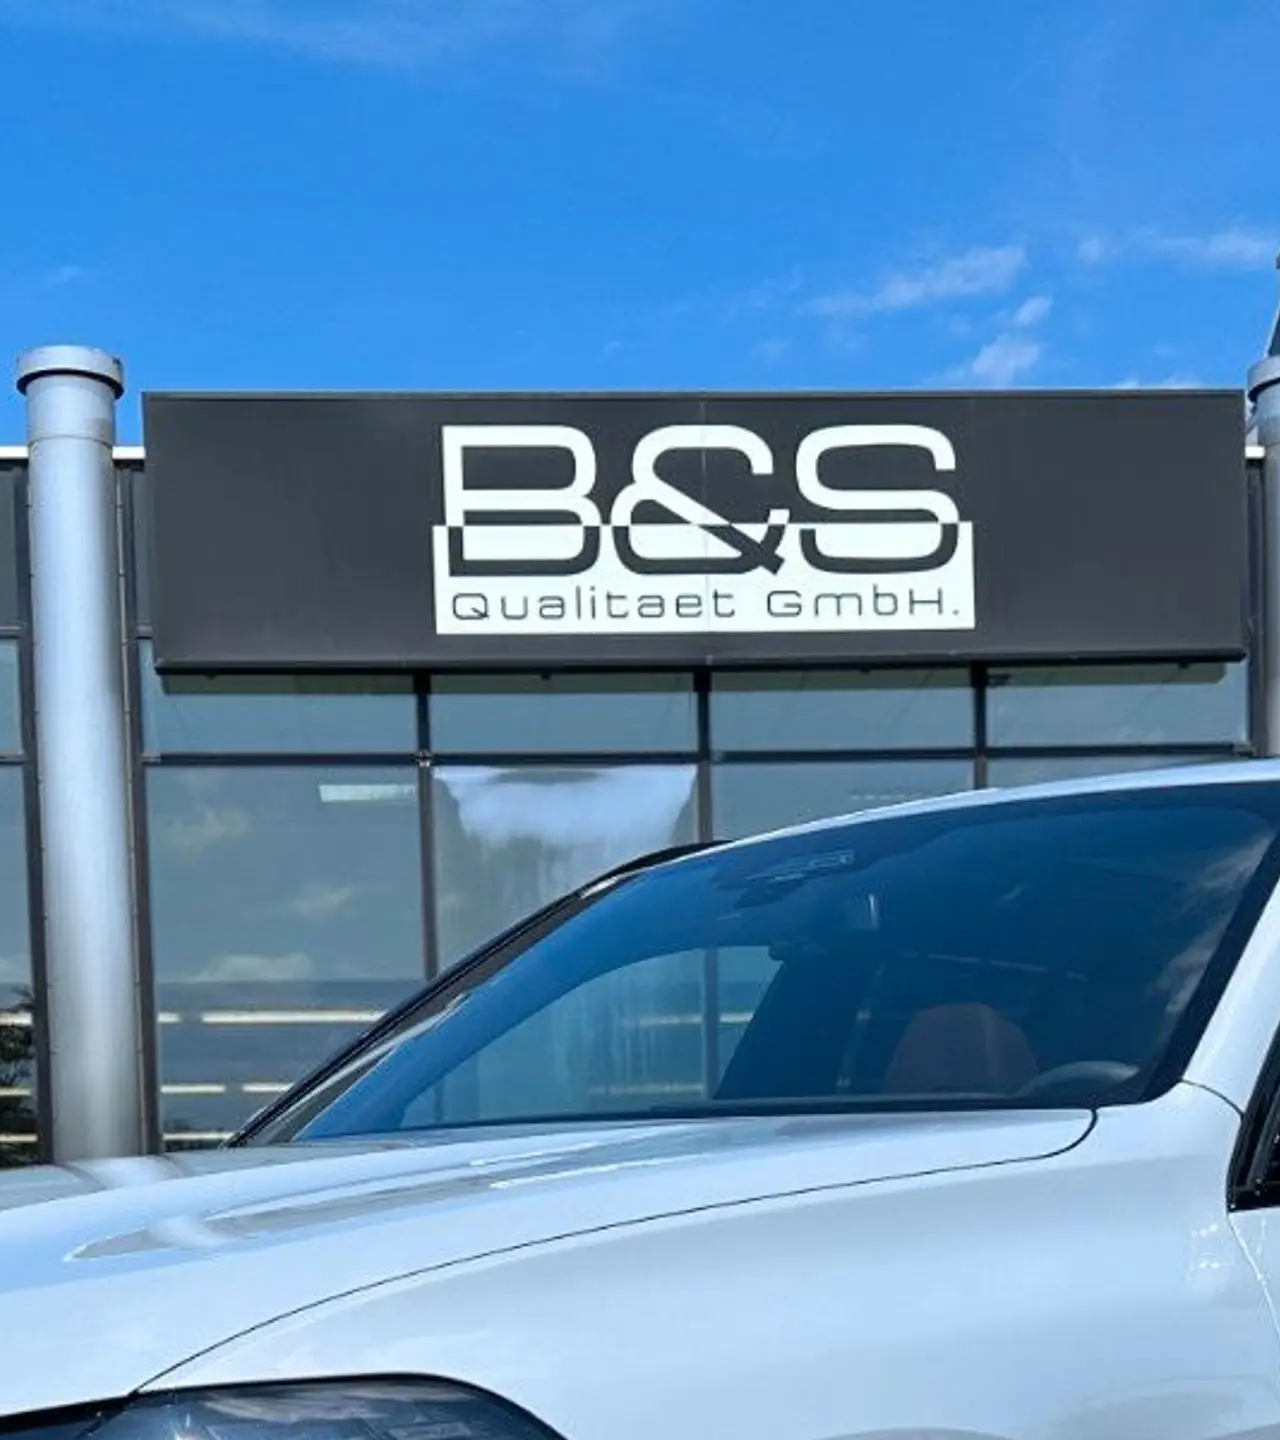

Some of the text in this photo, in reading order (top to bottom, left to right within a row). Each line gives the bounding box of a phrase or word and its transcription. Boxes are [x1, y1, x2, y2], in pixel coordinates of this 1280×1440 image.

[441, 423, 958, 577] B&S
[451, 584, 962, 621] Qualitaet GmbH.
